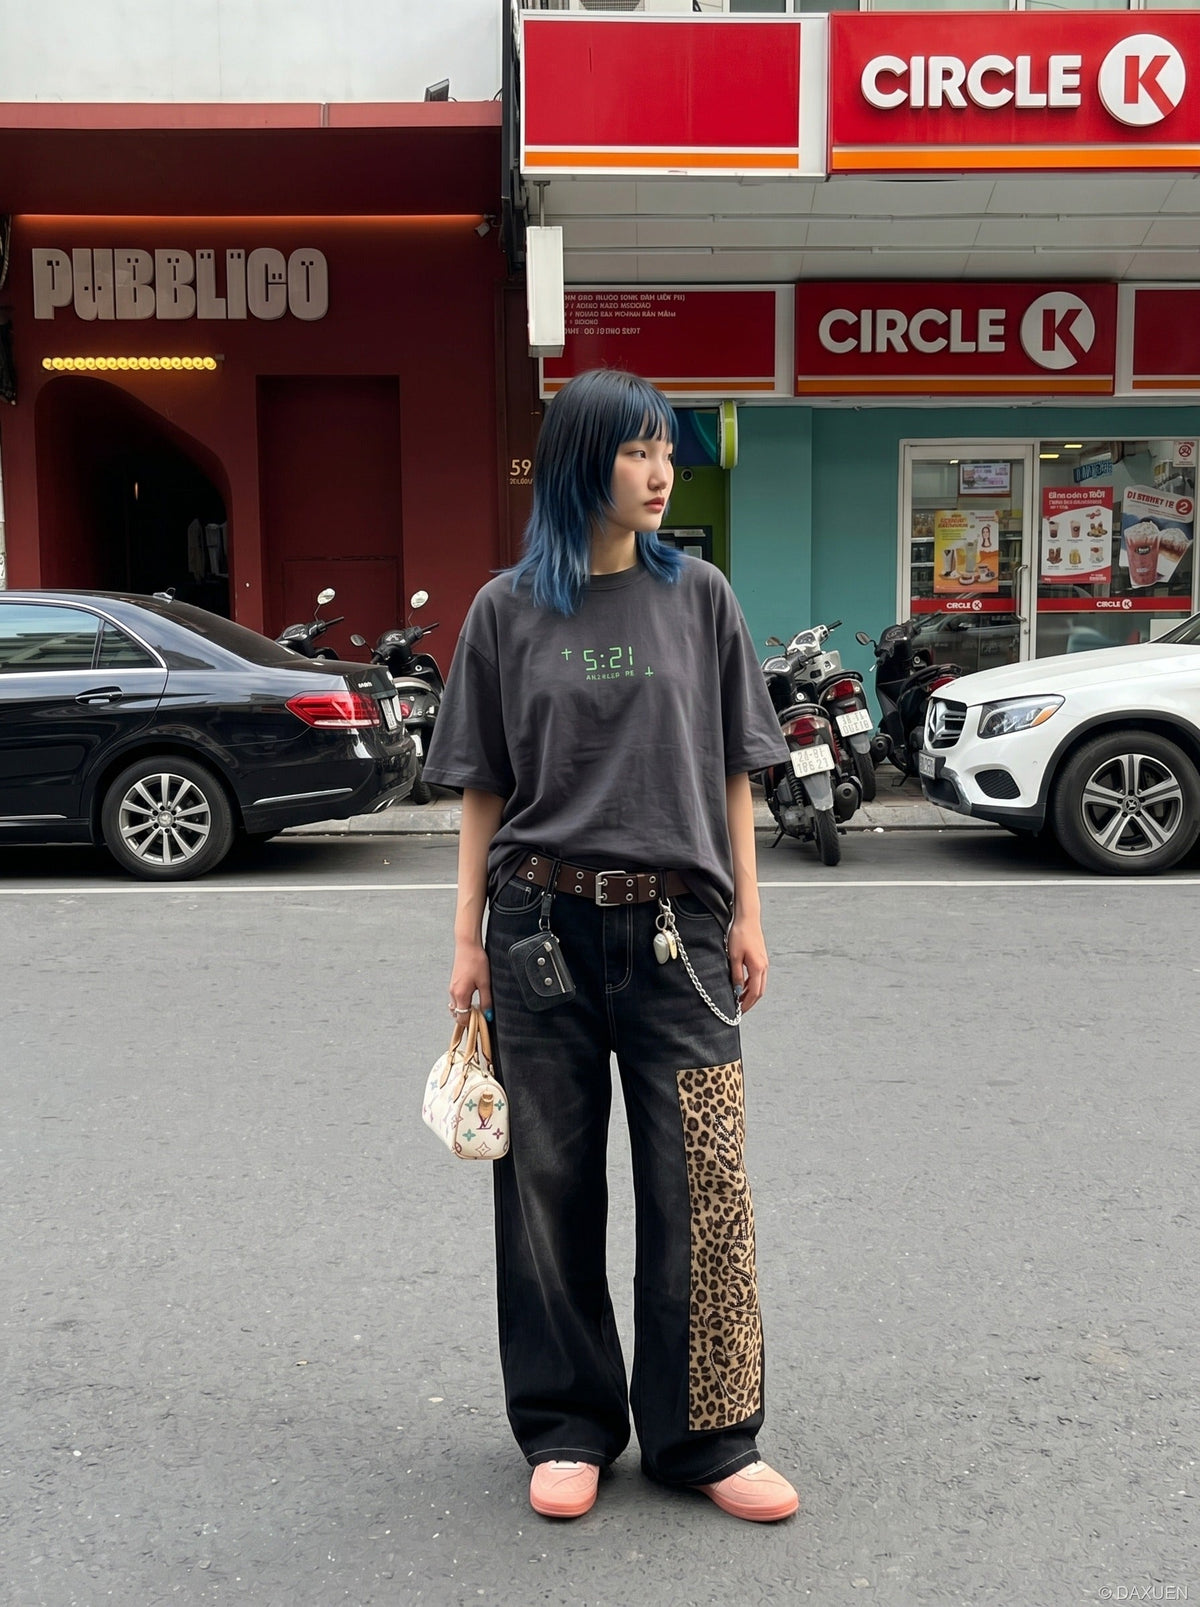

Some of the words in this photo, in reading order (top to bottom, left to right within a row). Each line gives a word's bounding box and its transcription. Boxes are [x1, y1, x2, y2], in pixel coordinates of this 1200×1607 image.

[861, 55, 1082, 110] CIRCLE
[818, 308, 1006, 354] CIRCLE
[510, 459, 532, 476] 59
[583, 646, 634, 671] 5:21
